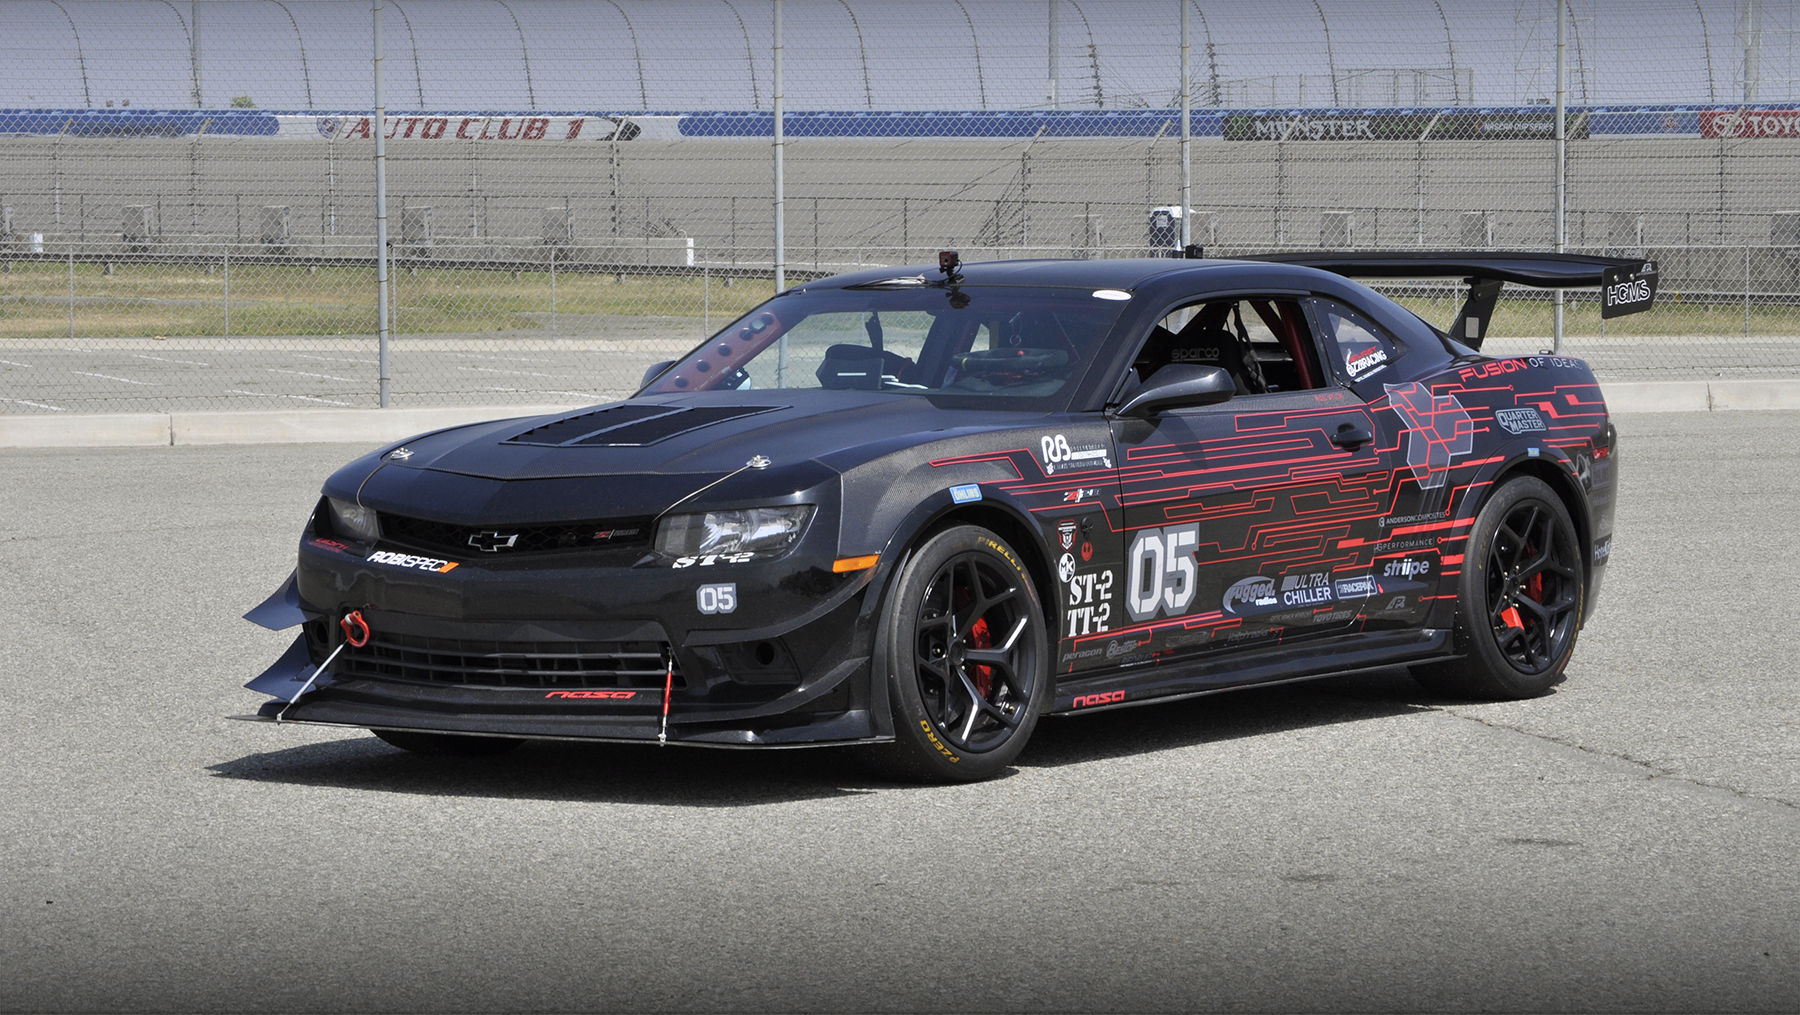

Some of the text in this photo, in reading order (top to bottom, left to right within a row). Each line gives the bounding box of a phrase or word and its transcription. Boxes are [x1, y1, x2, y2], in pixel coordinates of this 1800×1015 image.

[345, 118, 448, 139] AUTO
[456, 118, 549, 139] CLUB
[566, 118, 584, 139] 1
[1255, 117, 1375, 139] MONSTER
[1458, 358, 1528, 382] FUSION
[1528, 357, 1544, 367] OF
[1498, 411, 1538, 426] QUARTER
[1510, 419, 1543, 431] MASTER
[367, 551, 449, 572] ROBISPEC
[672, 552, 755, 569] ST-2
[977, 536, 1022, 571] PIRELLI
[1127, 526, 1198, 617] 05
[1295, 572, 1329, 589] ULTRA
[698, 585, 736, 612] 05
[1069, 570, 1113, 606] ST-2
[1283, 587, 1332, 605] CHILLER
[1067, 603, 1110, 638] TT-2
